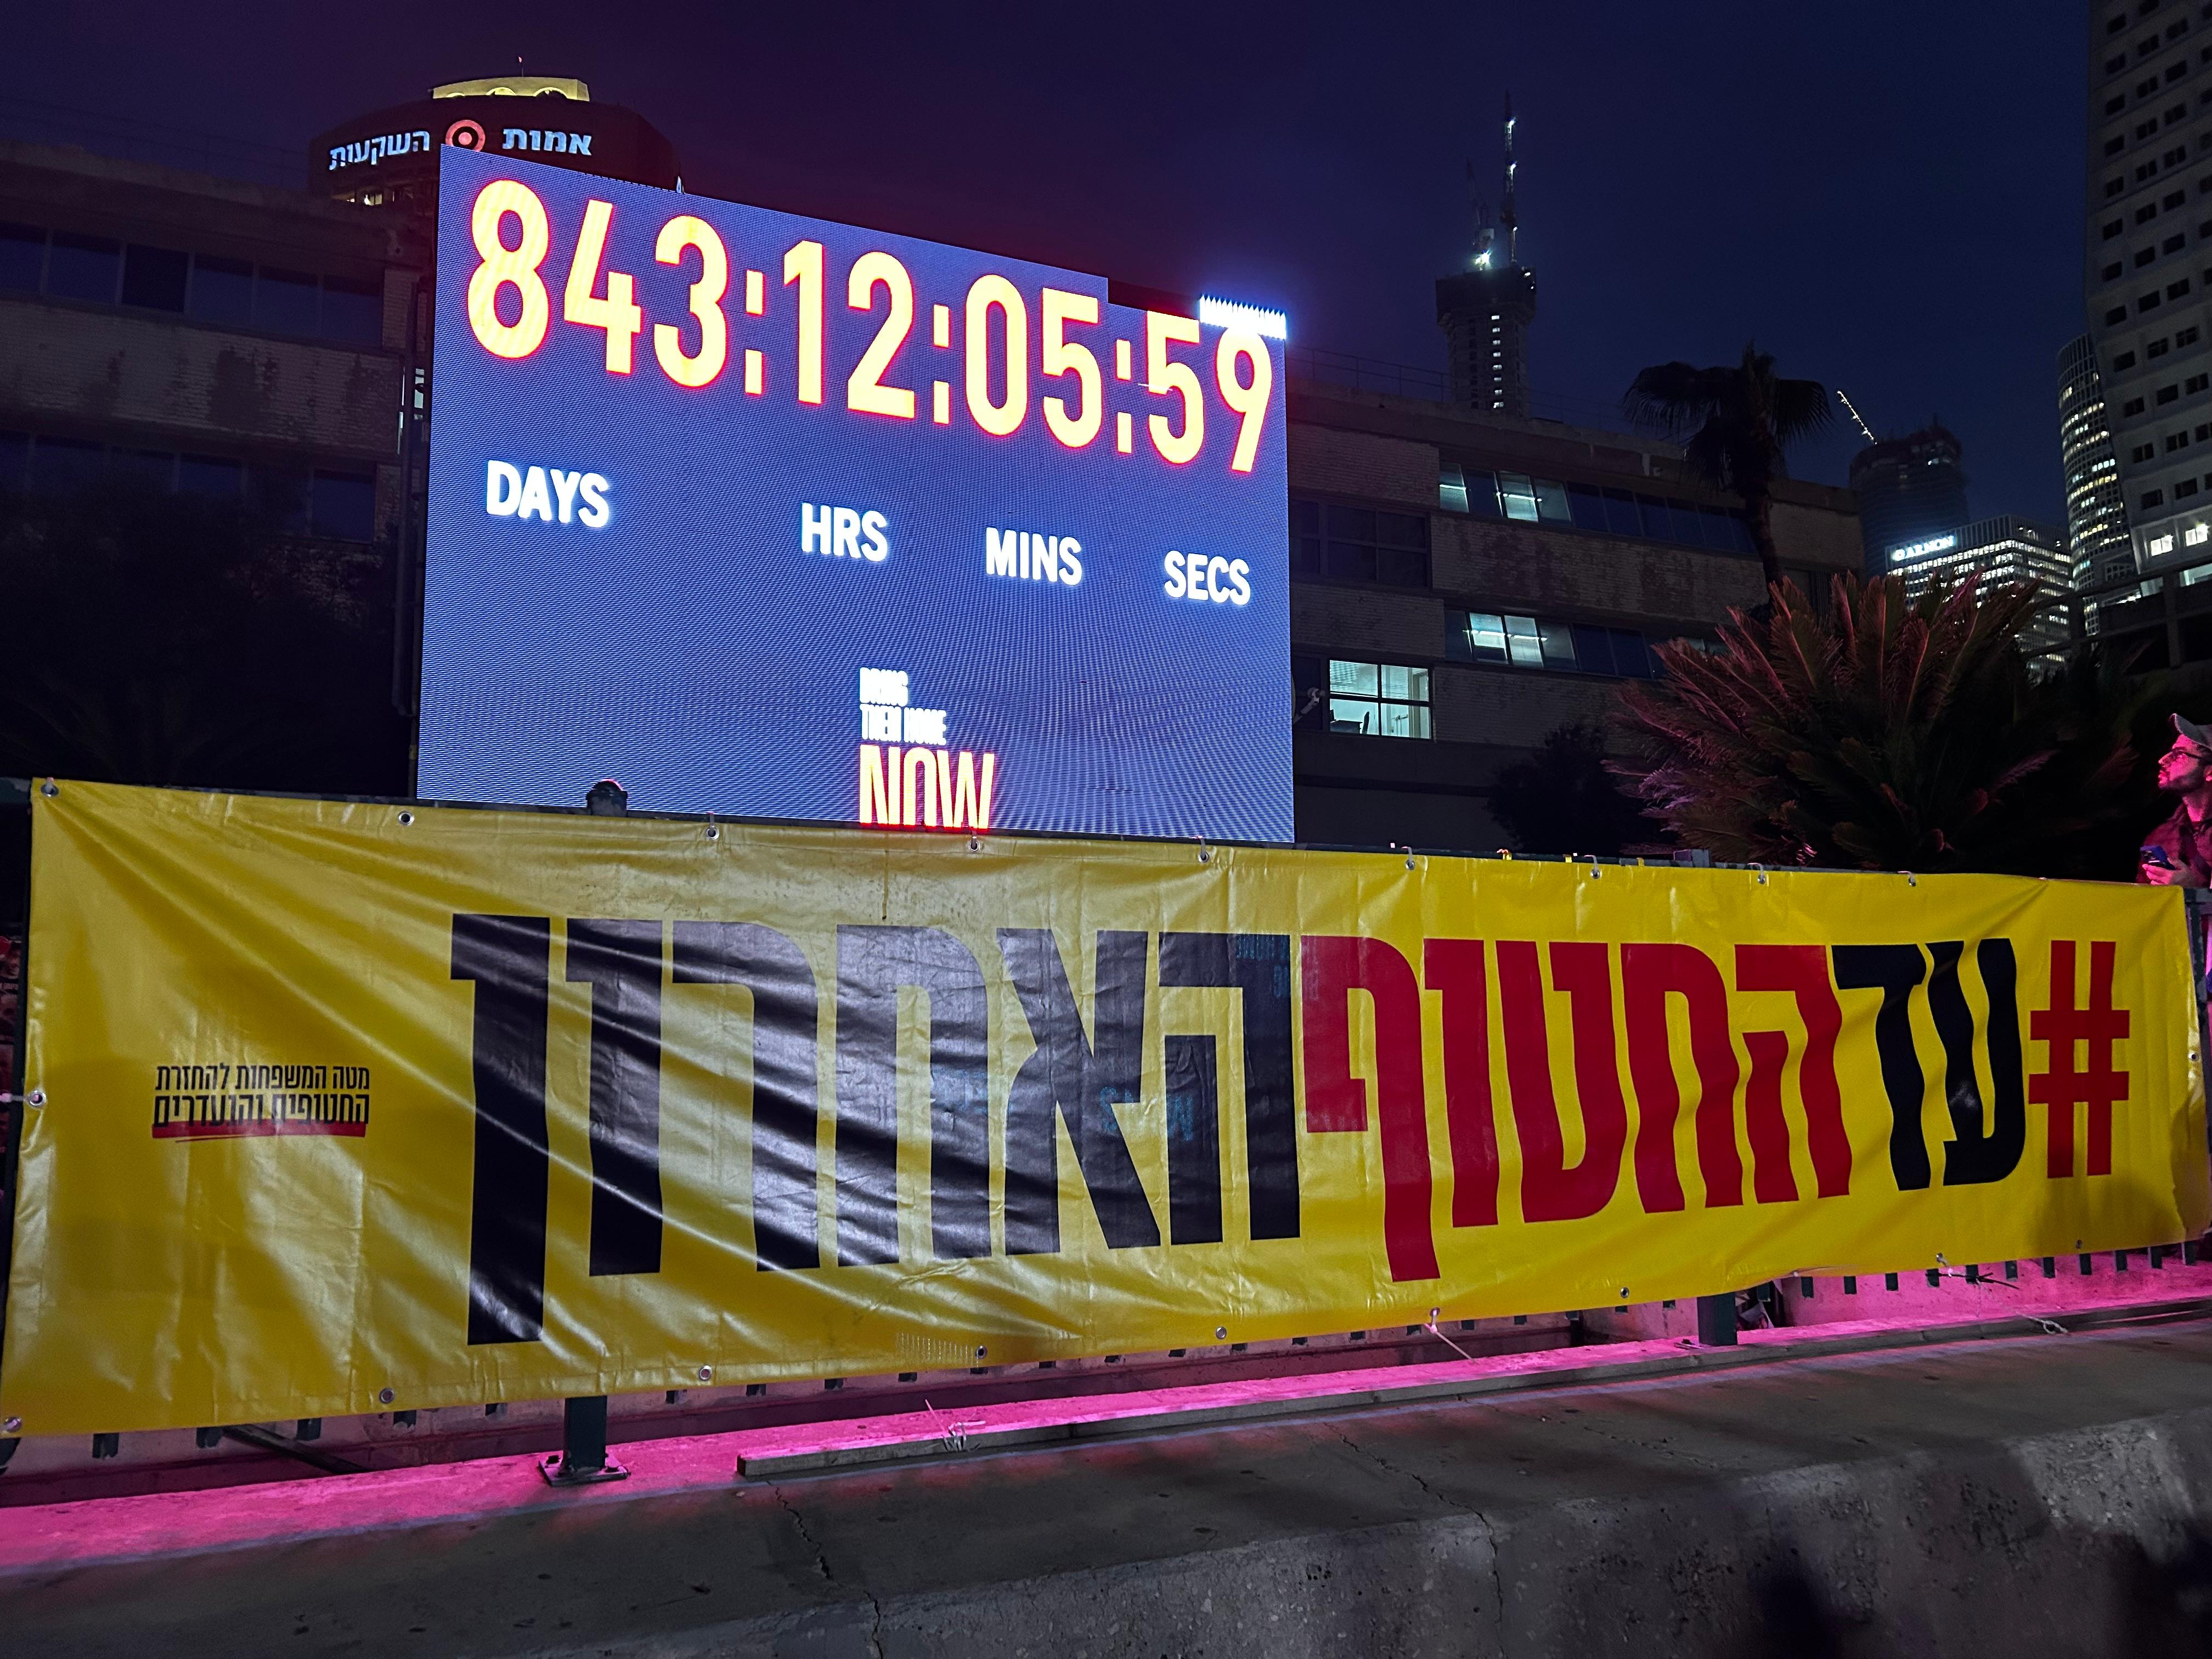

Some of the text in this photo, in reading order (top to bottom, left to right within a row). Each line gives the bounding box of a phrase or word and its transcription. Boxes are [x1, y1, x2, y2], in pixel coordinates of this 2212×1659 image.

[329, 128, 592, 171] אמות השקעות
[467, 179, 1274, 473] 843:12:05:59
[486, 460, 610, 528] DAYS
[802, 503, 888, 562] HRS
[986, 527, 1082, 585] MINS
[1164, 550, 1251, 605] SECS
[859, 744, 995, 829] NOW
[155, 1062, 370, 1091] מטה המשפחות להחזרת
[153, 1093, 370, 1128] החטופים והנעדרים
